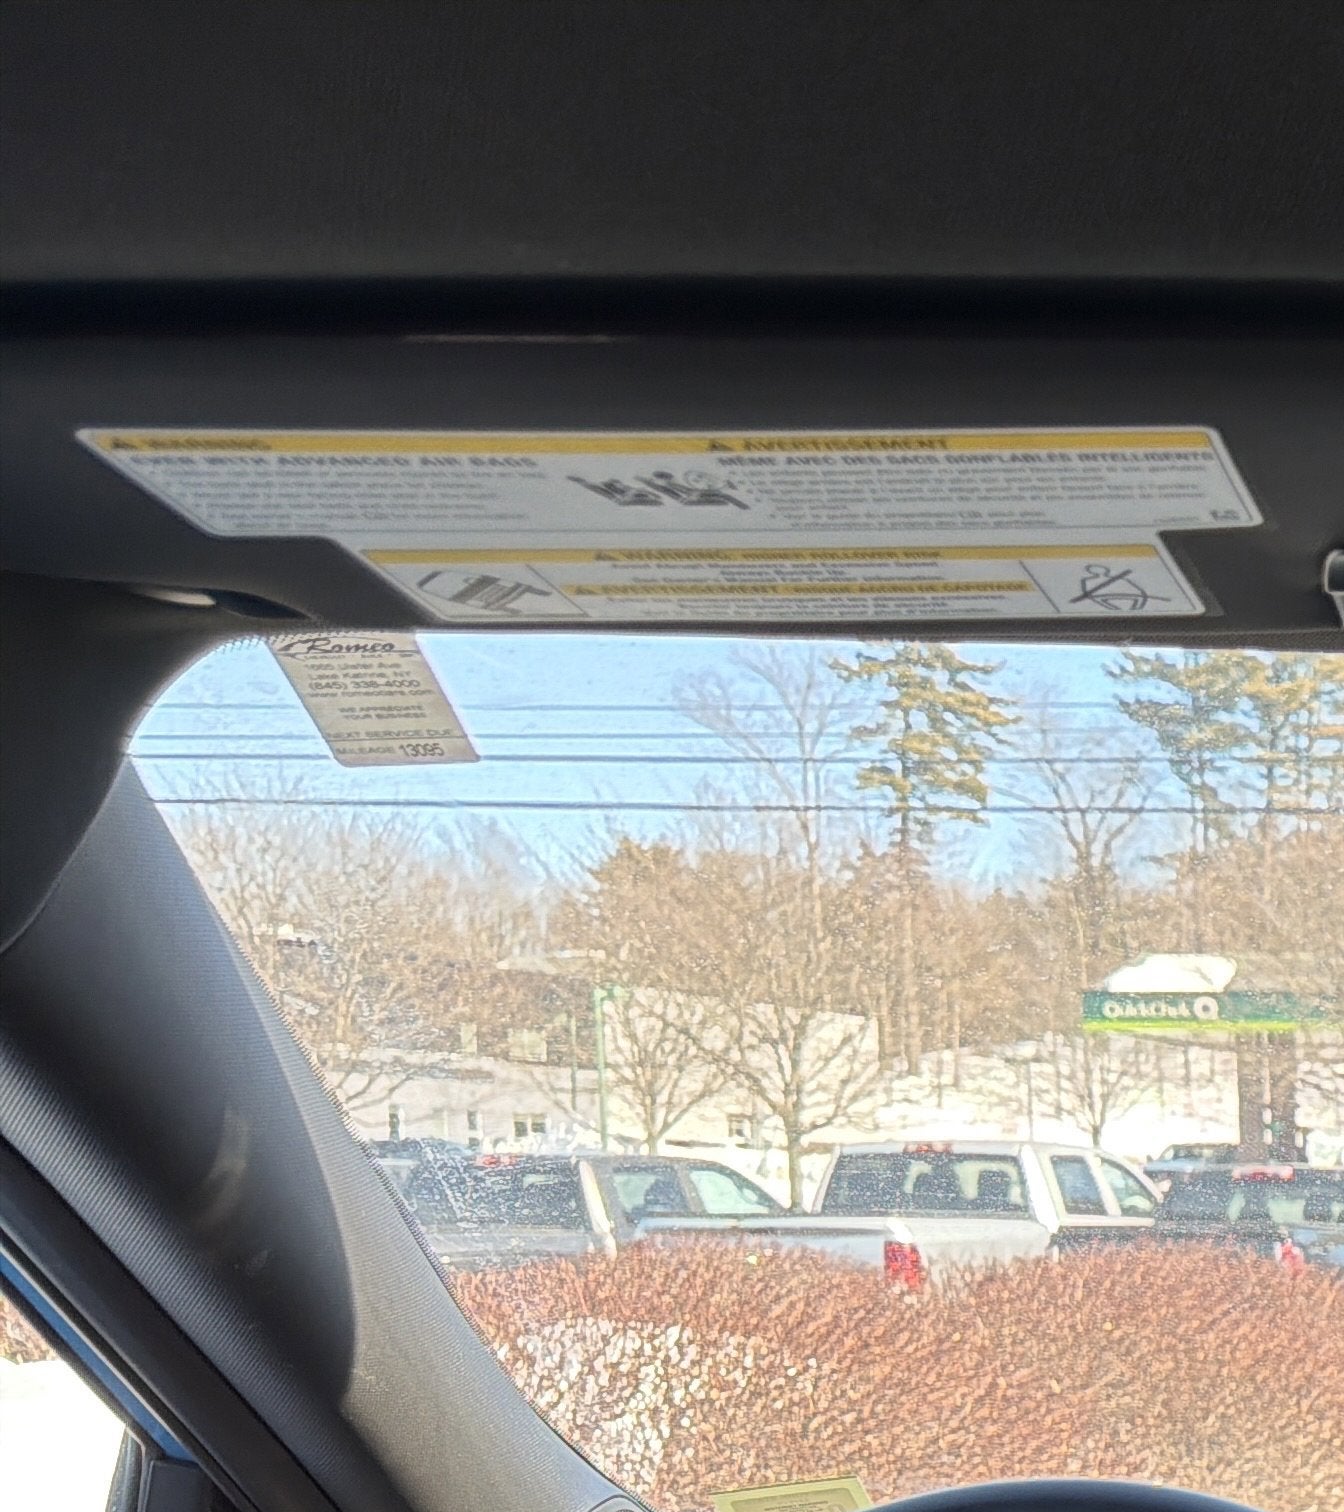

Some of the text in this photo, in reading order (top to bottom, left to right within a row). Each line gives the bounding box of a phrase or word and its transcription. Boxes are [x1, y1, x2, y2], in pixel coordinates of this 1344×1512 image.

[307, 637, 395, 654] Romeo
[308, 681, 348, 691] (845)
[365, 730, 420, 738] SERVICE
[399, 743, 446, 758] 13095
